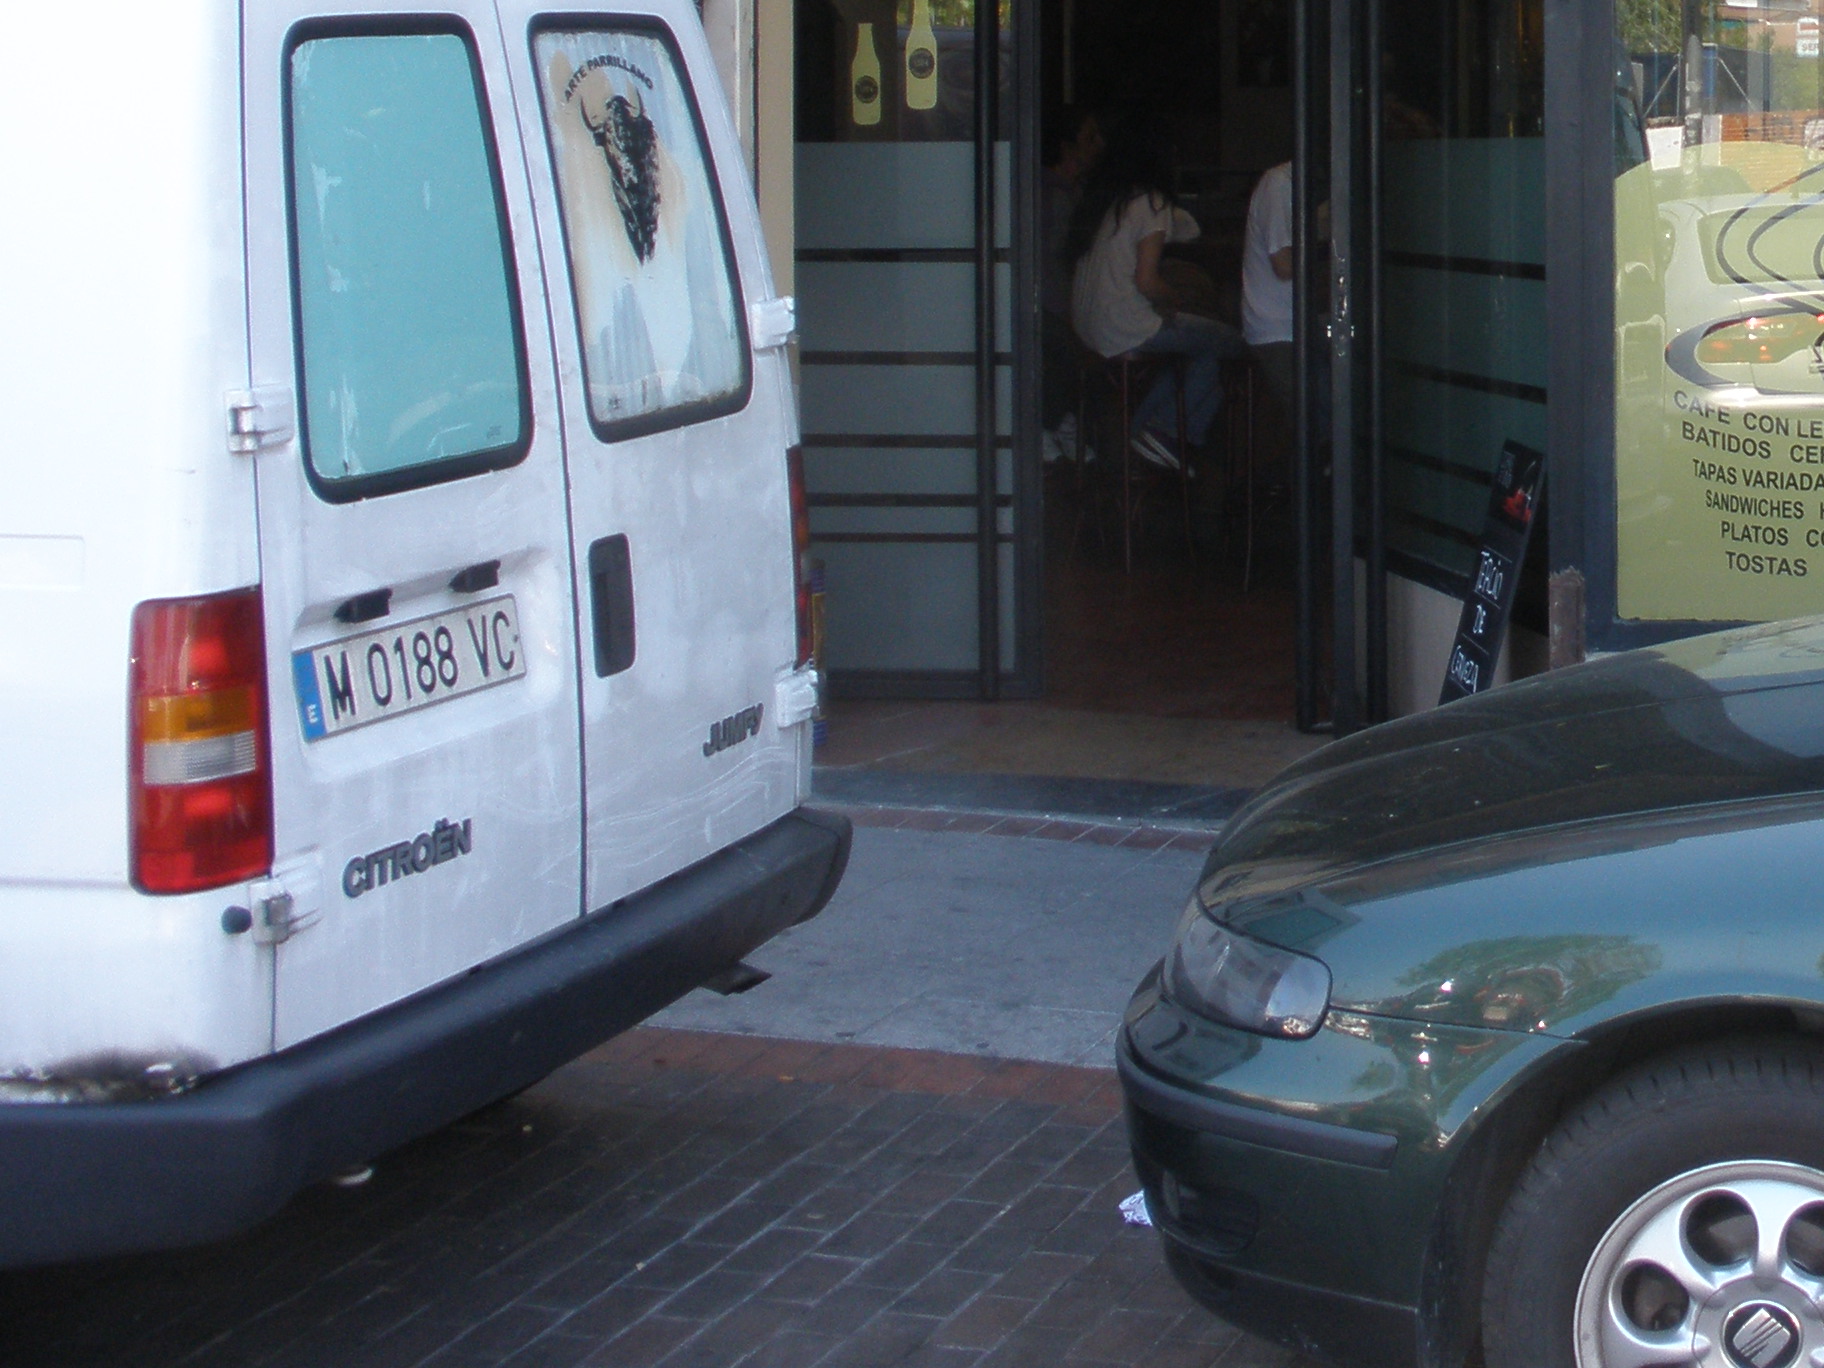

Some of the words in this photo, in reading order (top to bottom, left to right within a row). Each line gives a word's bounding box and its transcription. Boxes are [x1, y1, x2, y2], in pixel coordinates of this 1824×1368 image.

[565, 64, 587, 104] ARTE
[1673, 390, 1731, 425] CAFE
[1743, 411, 1789, 438] CON
[1681, 420, 1772, 460] BATIDOS
[1692, 458, 1738, 486] TAPAS
[1705, 489, 1805, 520] SANDWICHES
[1720, 520, 1789, 546] PLATOS
[1725, 550, 1808, 578] TOSTAS
[324, 650, 356, 720] M
[367, 625, 459, 707] 0188
[467, 610, 516, 678] VC
[702, 702, 765, 757] JUMPY
[342, 817, 472, 899] CITROËN
